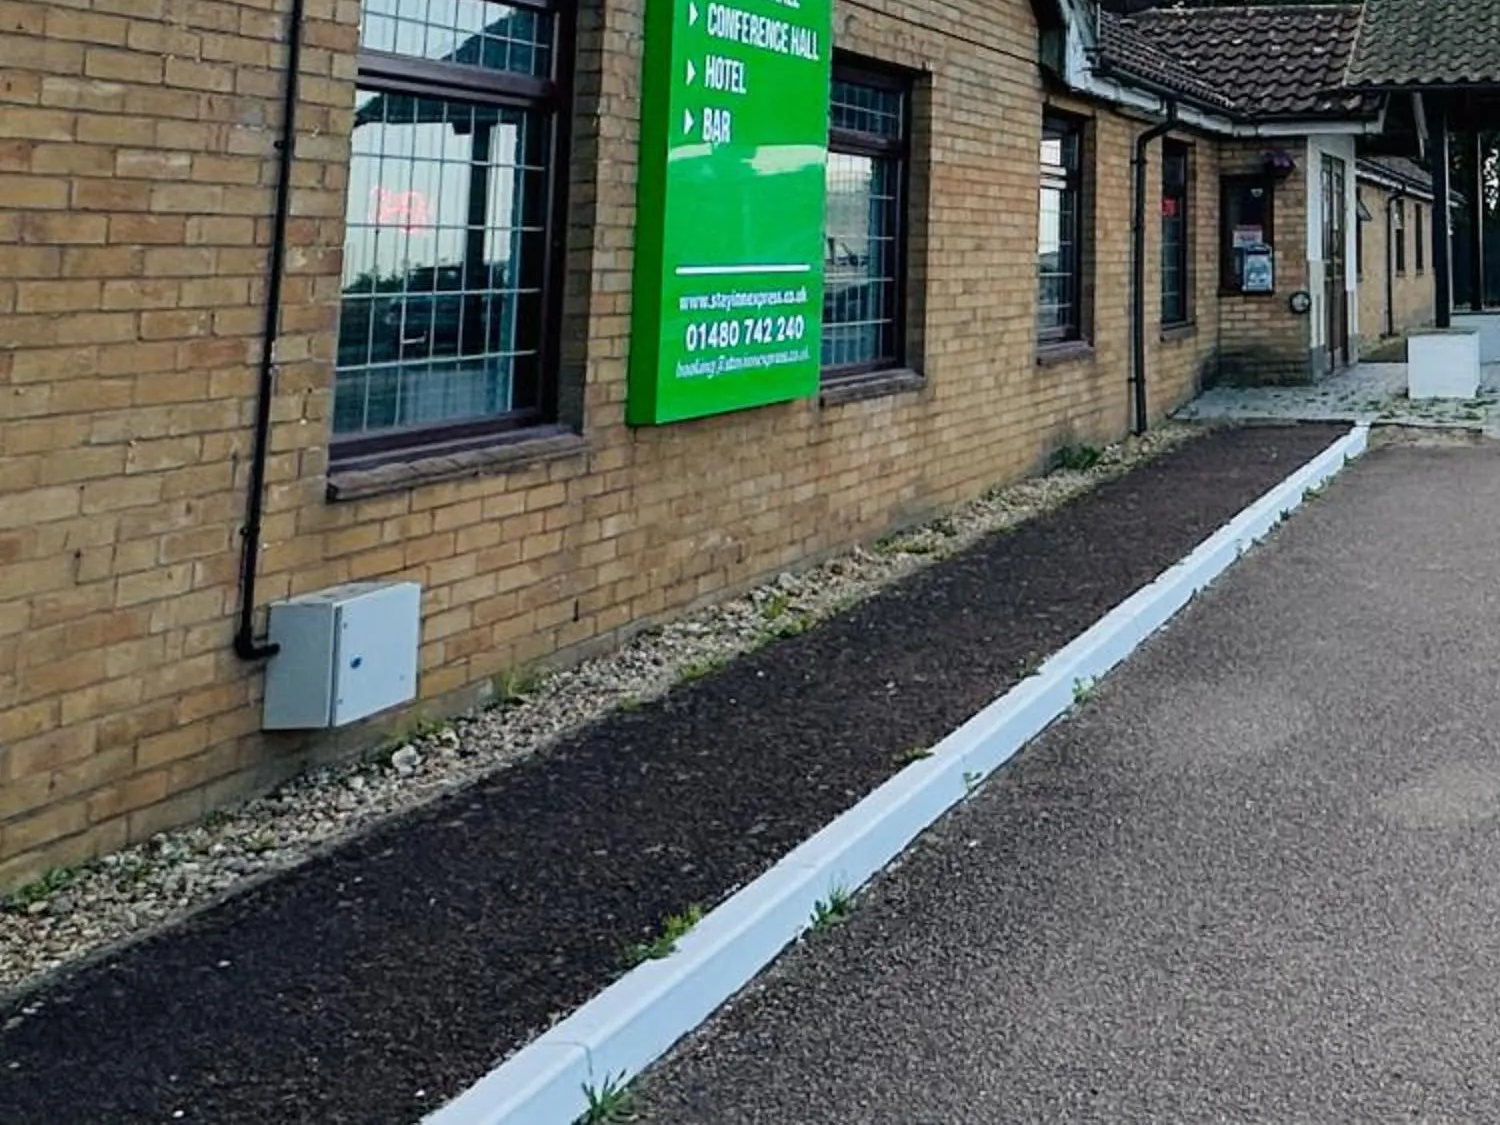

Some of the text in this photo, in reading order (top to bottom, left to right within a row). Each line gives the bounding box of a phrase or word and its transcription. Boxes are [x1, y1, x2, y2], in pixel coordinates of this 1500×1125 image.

[707, 2, 820, 61] CONFERENCE HALL
[704, 54, 747, 94] HOTEL
[702, 106, 732, 143] BAR
[686, 314, 805, 352] 01480 742 240
